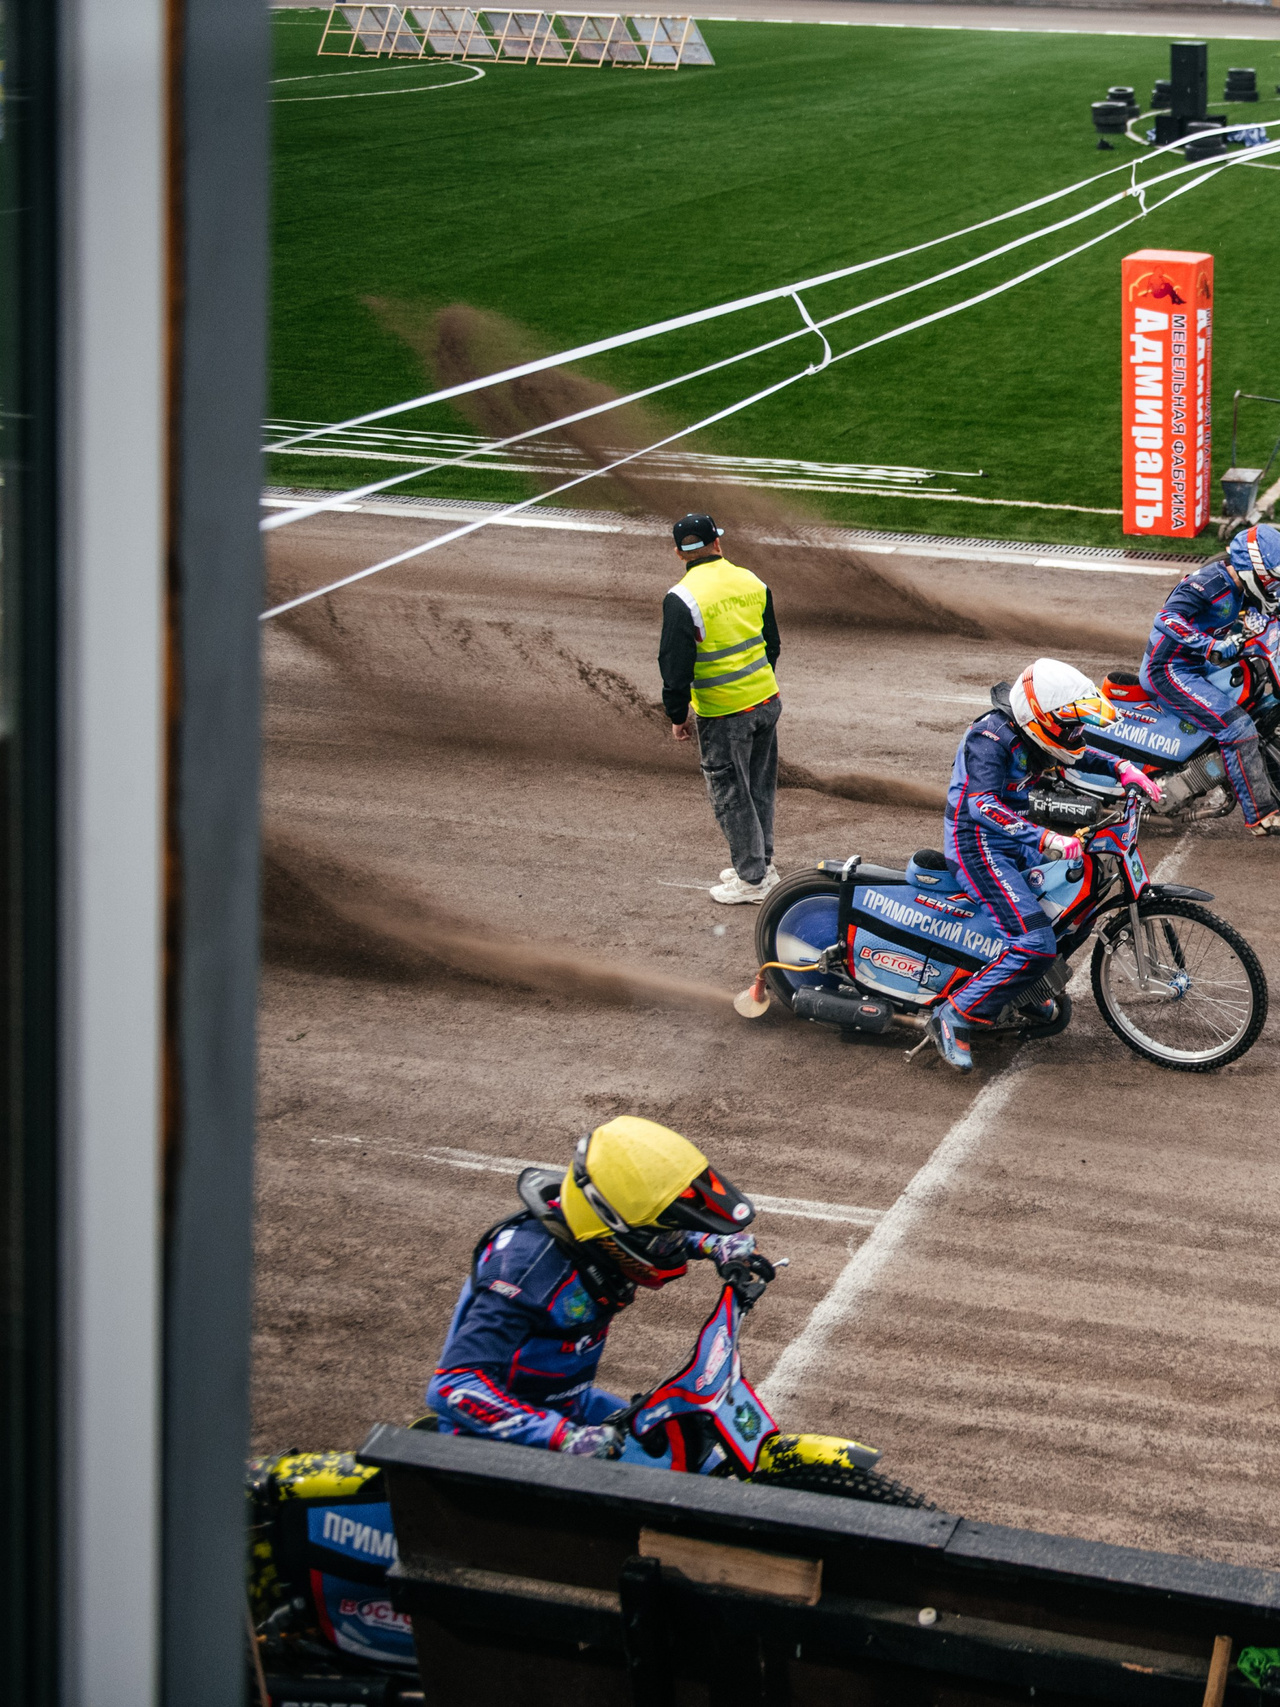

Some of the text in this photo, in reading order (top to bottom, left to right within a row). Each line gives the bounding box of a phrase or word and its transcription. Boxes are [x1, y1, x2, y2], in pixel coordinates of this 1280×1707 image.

[1171, 314, 1187, 530] МЕБЕЛЬНАЯ ФАБРИКА
[1117, 707, 1158, 724] ЕКТОР
[1147, 732, 1181, 756] КРАЙ
[914, 894, 976, 919] ВЕКТОР
[862, 889, 1003, 958] ПРИМОРСКИЙ КРАЙ
[861, 948, 918, 974] ВОСТОК
